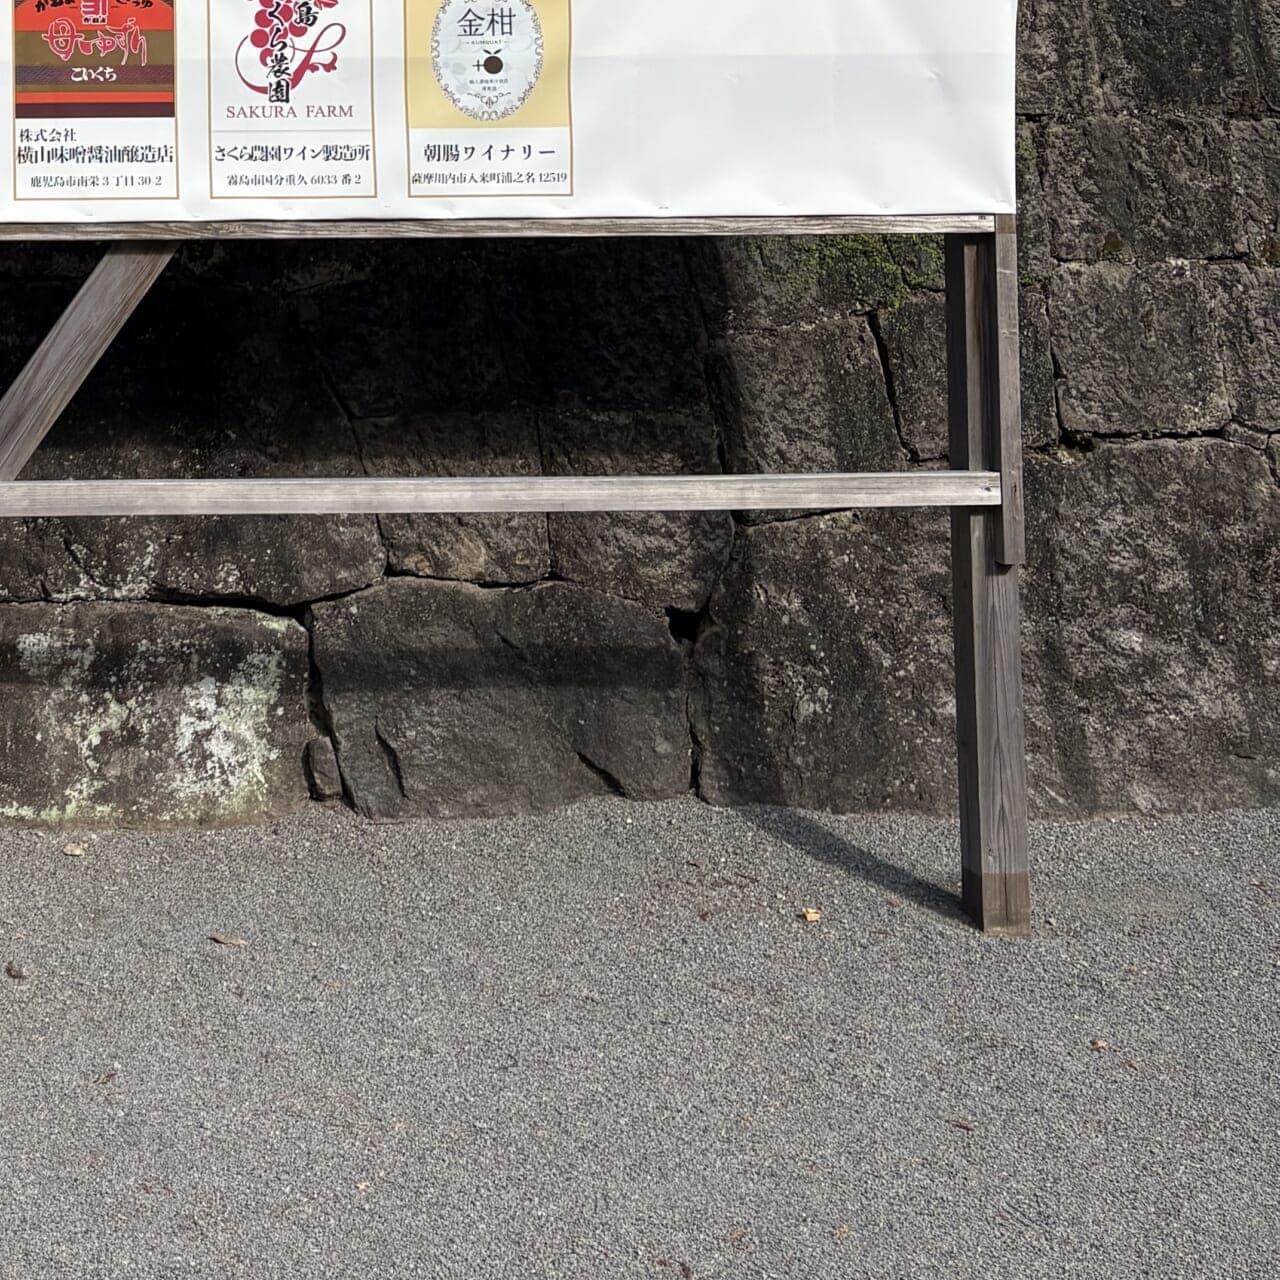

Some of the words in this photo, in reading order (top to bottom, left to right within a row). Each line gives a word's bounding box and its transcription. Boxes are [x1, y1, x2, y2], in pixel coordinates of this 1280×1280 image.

[457, 8, 516, 37] 金柑
[70, 67, 117, 82] こいくち
[226, 106, 297, 118] SAKURA
[306, 106, 353, 118] FARM
[19, 128, 76, 142] 株式会社
[215, 144, 370, 162] さくら農園ワイン製造所
